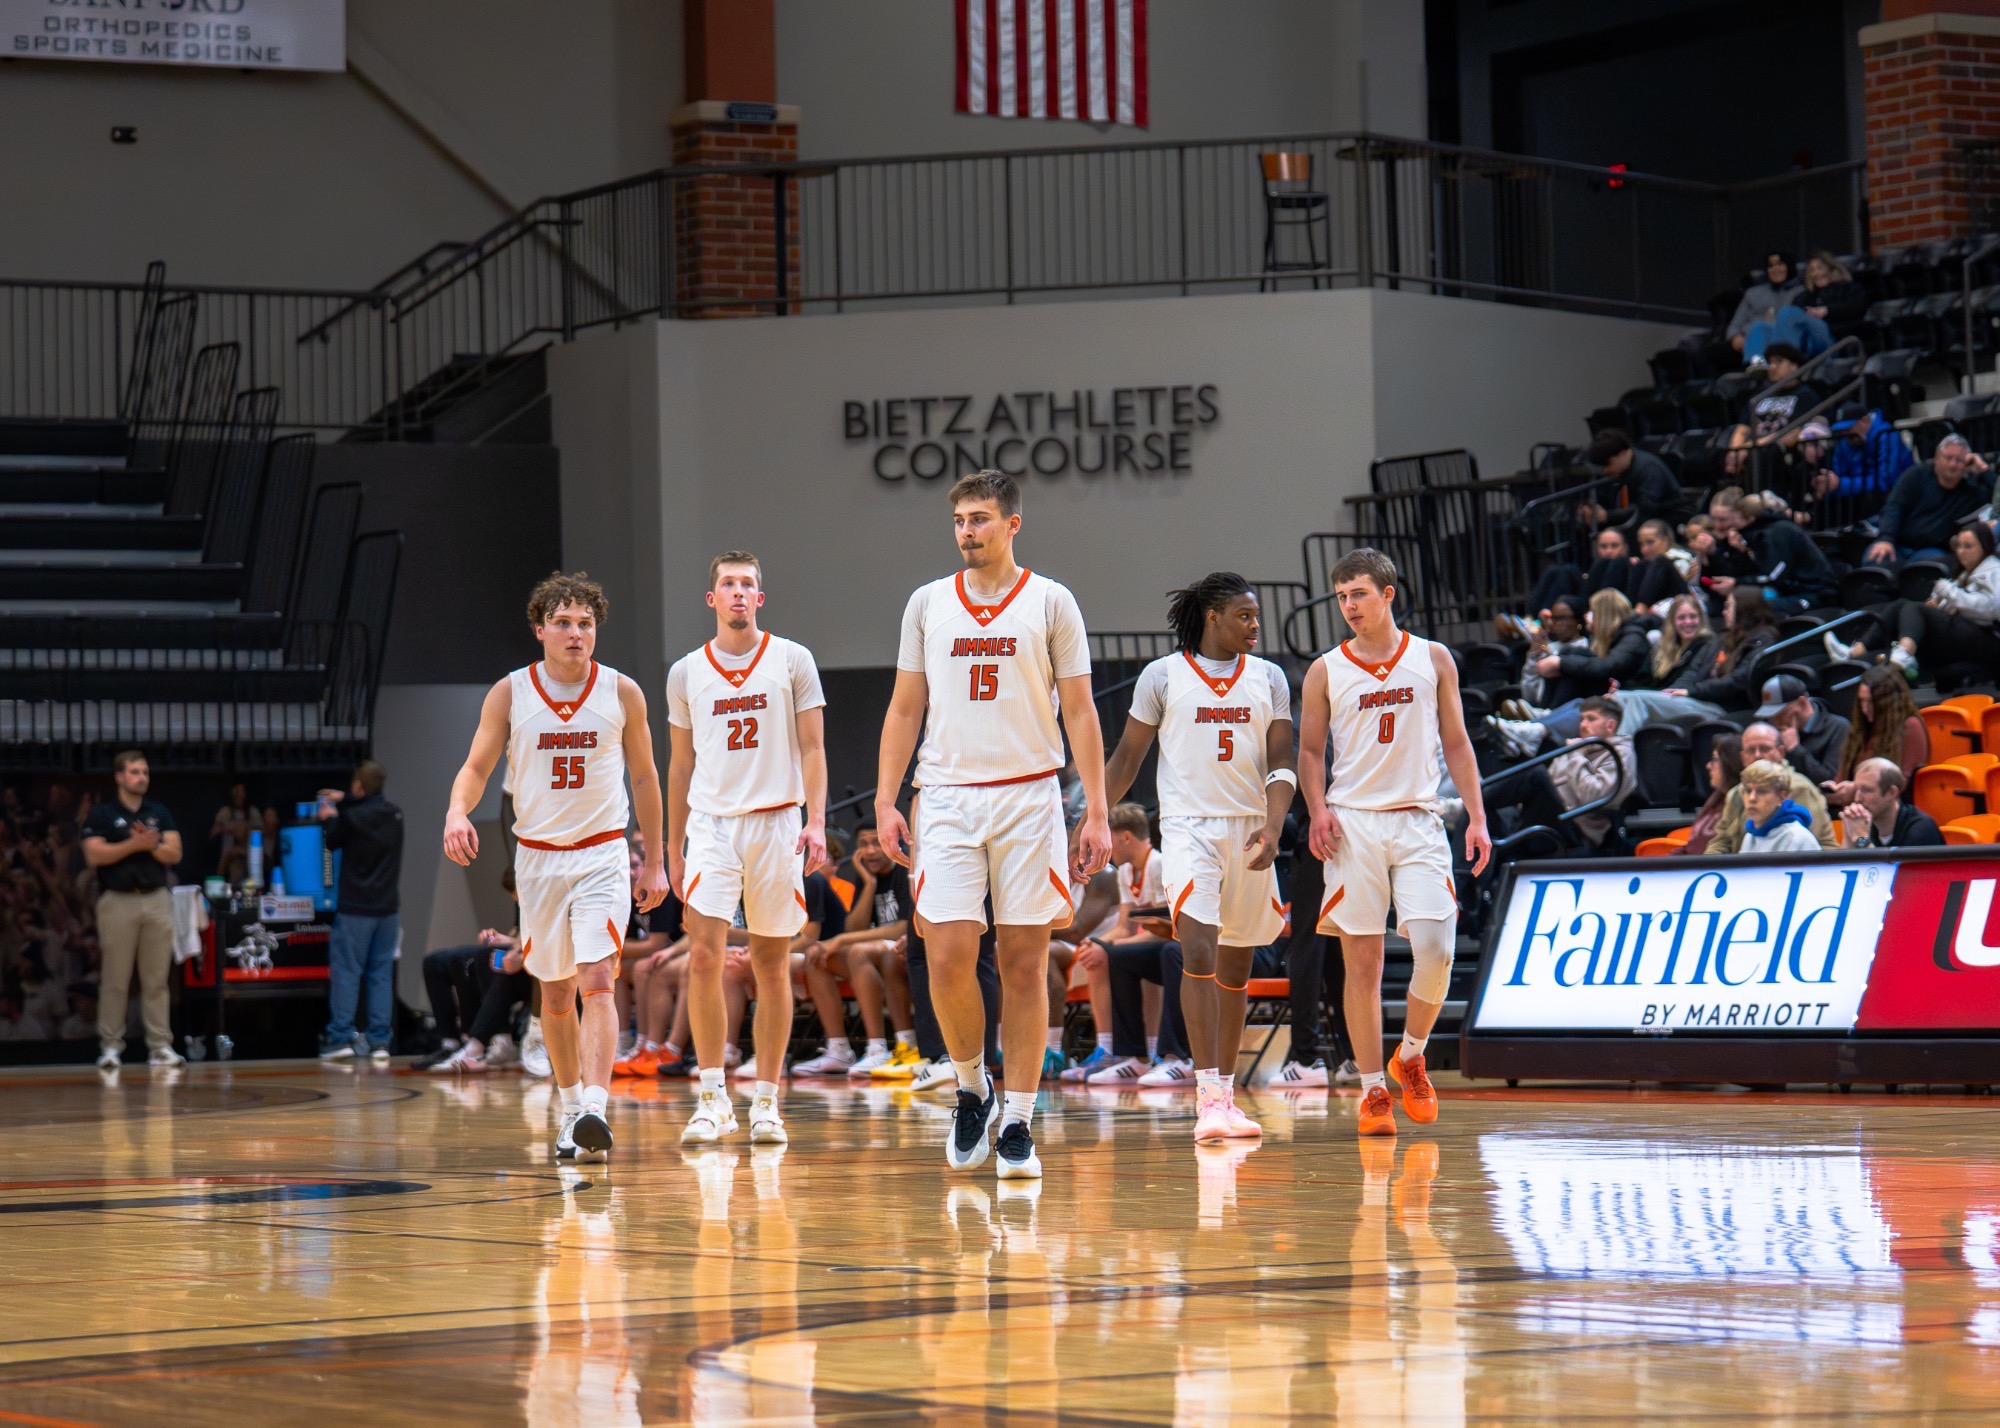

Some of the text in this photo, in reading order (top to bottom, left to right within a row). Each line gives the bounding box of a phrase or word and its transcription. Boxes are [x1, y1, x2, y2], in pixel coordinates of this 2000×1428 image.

[44, 16, 251, 41] ORTHOPEDICS
[13, 34, 283, 62] SPORTS MEDICINE
[844, 384, 1219, 439] BIETZ ATHLETES
[873, 430, 1192, 481] CONCOURSE
[950, 637, 1017, 657] JIMMIES
[969, 664, 999, 701] 15
[712, 693, 767, 716] JIMMIES
[1358, 686, 1414, 712] JIMMIES
[1194, 706, 1251, 724] JIMMIES
[1377, 711, 1395, 744] 0
[536, 731, 598, 750] JIMMIES
[727, 717, 758, 751] 22
[1217, 729, 1233, 762] 5
[550, 755, 586, 790] 55
[1503, 870, 1859, 987] Fairfield
[1640, 1001, 1831, 1026] BY MARRIOTT
